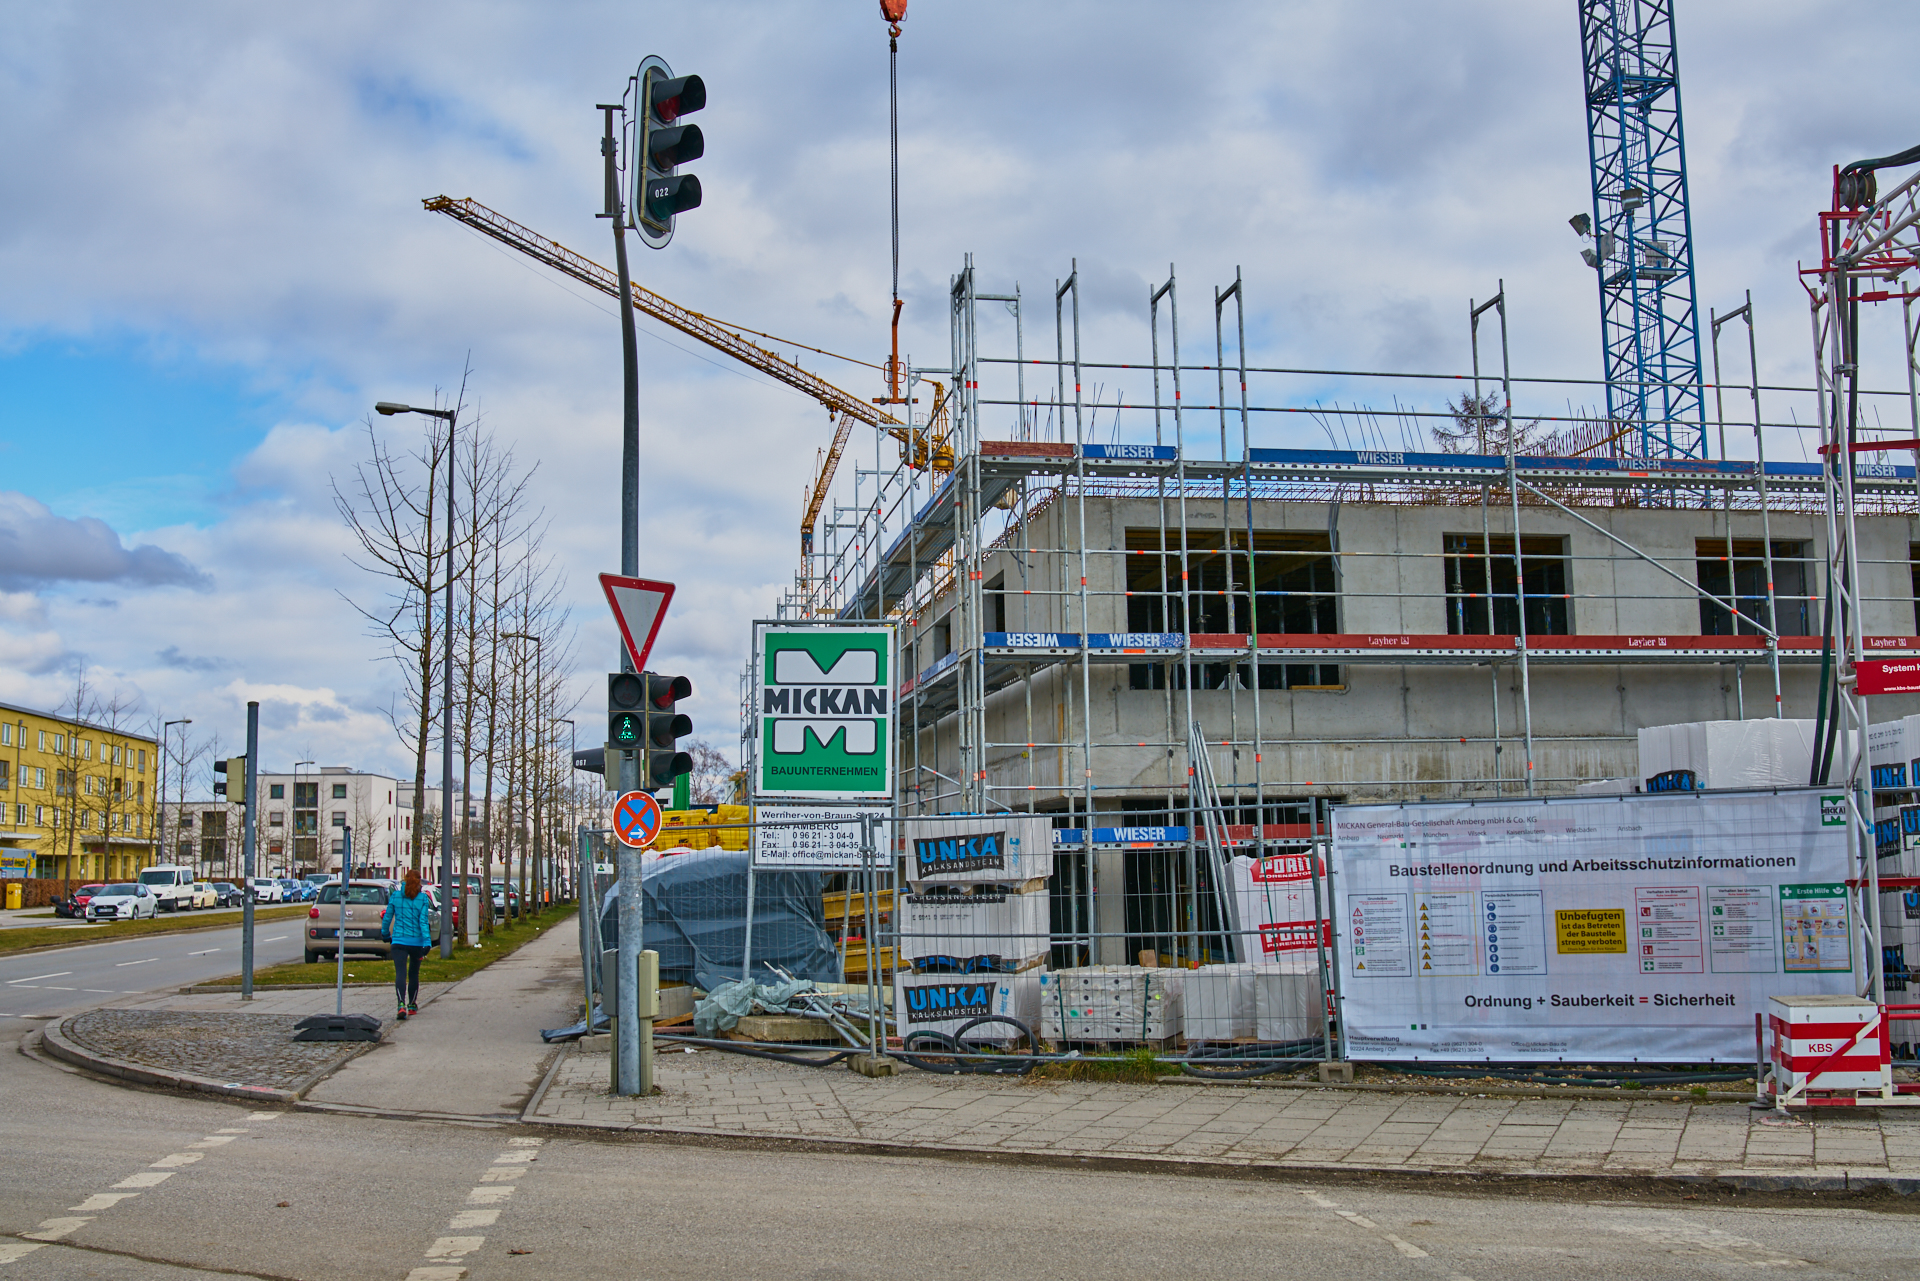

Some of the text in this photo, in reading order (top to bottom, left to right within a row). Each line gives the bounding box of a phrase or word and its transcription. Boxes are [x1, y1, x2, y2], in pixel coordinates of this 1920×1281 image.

[655, 187, 669, 199] 022
[1104, 445, 1154, 459] WIESER
[1356, 451, 1404, 465] WIESER
[1616, 458, 1662, 471] WIESER
[1855, 464, 1897, 477] WIESER
[1007, 632, 1060, 647] WIESER
[1109, 633, 1161, 647] WIESER
[1368, 636, 1398, 646] Layher
[1628, 637, 1656, 648] Layher
[1870, 638, 1897, 648] Layher
[1882, 664, 1916, 674] System
[764, 688, 887, 715] MICKAN
[771, 766, 878, 776] BAUUNTERNEHMEN
[793, 822, 839, 831] AMBERG
[1337, 822, 1366, 830] MICKAN
[1367, 818, 1455, 829] General-Bau-Gesellschaft
[1456, 818, 1485, 827] Amberg
[1487, 817, 1504, 825] mbH
[1513, 816, 1525, 824] Co.
[1527, 816, 1538, 824] KG
[1113, 826, 1166, 841] WIESER
[1338, 834, 1359, 842] Amberg
[1506, 828, 1546, 836] Kaiserslautern
[1565, 826, 1598, 834] Wiesbaden
[761, 841, 780, 849] Fax:
[792, 841, 798, 849] 0
[799, 841, 810, 849] 96
[811, 841, 822, 849] 21
[921, 858, 1000, 875] KALKSANDSTEIN
[1260, 857, 1313, 874] PORIT
[1389, 855, 1796, 877] Baustellenordnung und Arbeitsschutzinformationen
[1560, 911, 1621, 922] Unbefugten
[1561, 922, 1571, 930] ist
[1572, 922, 1586, 930] das
[1561, 939, 1586, 947] streng
[1464, 993, 1736, 1010] Ordnung + Sauberkeit = Sicherheit
[912, 1007, 988, 1019] KALKSANDSTEIN
[1808, 1043, 1833, 1053] KBS
